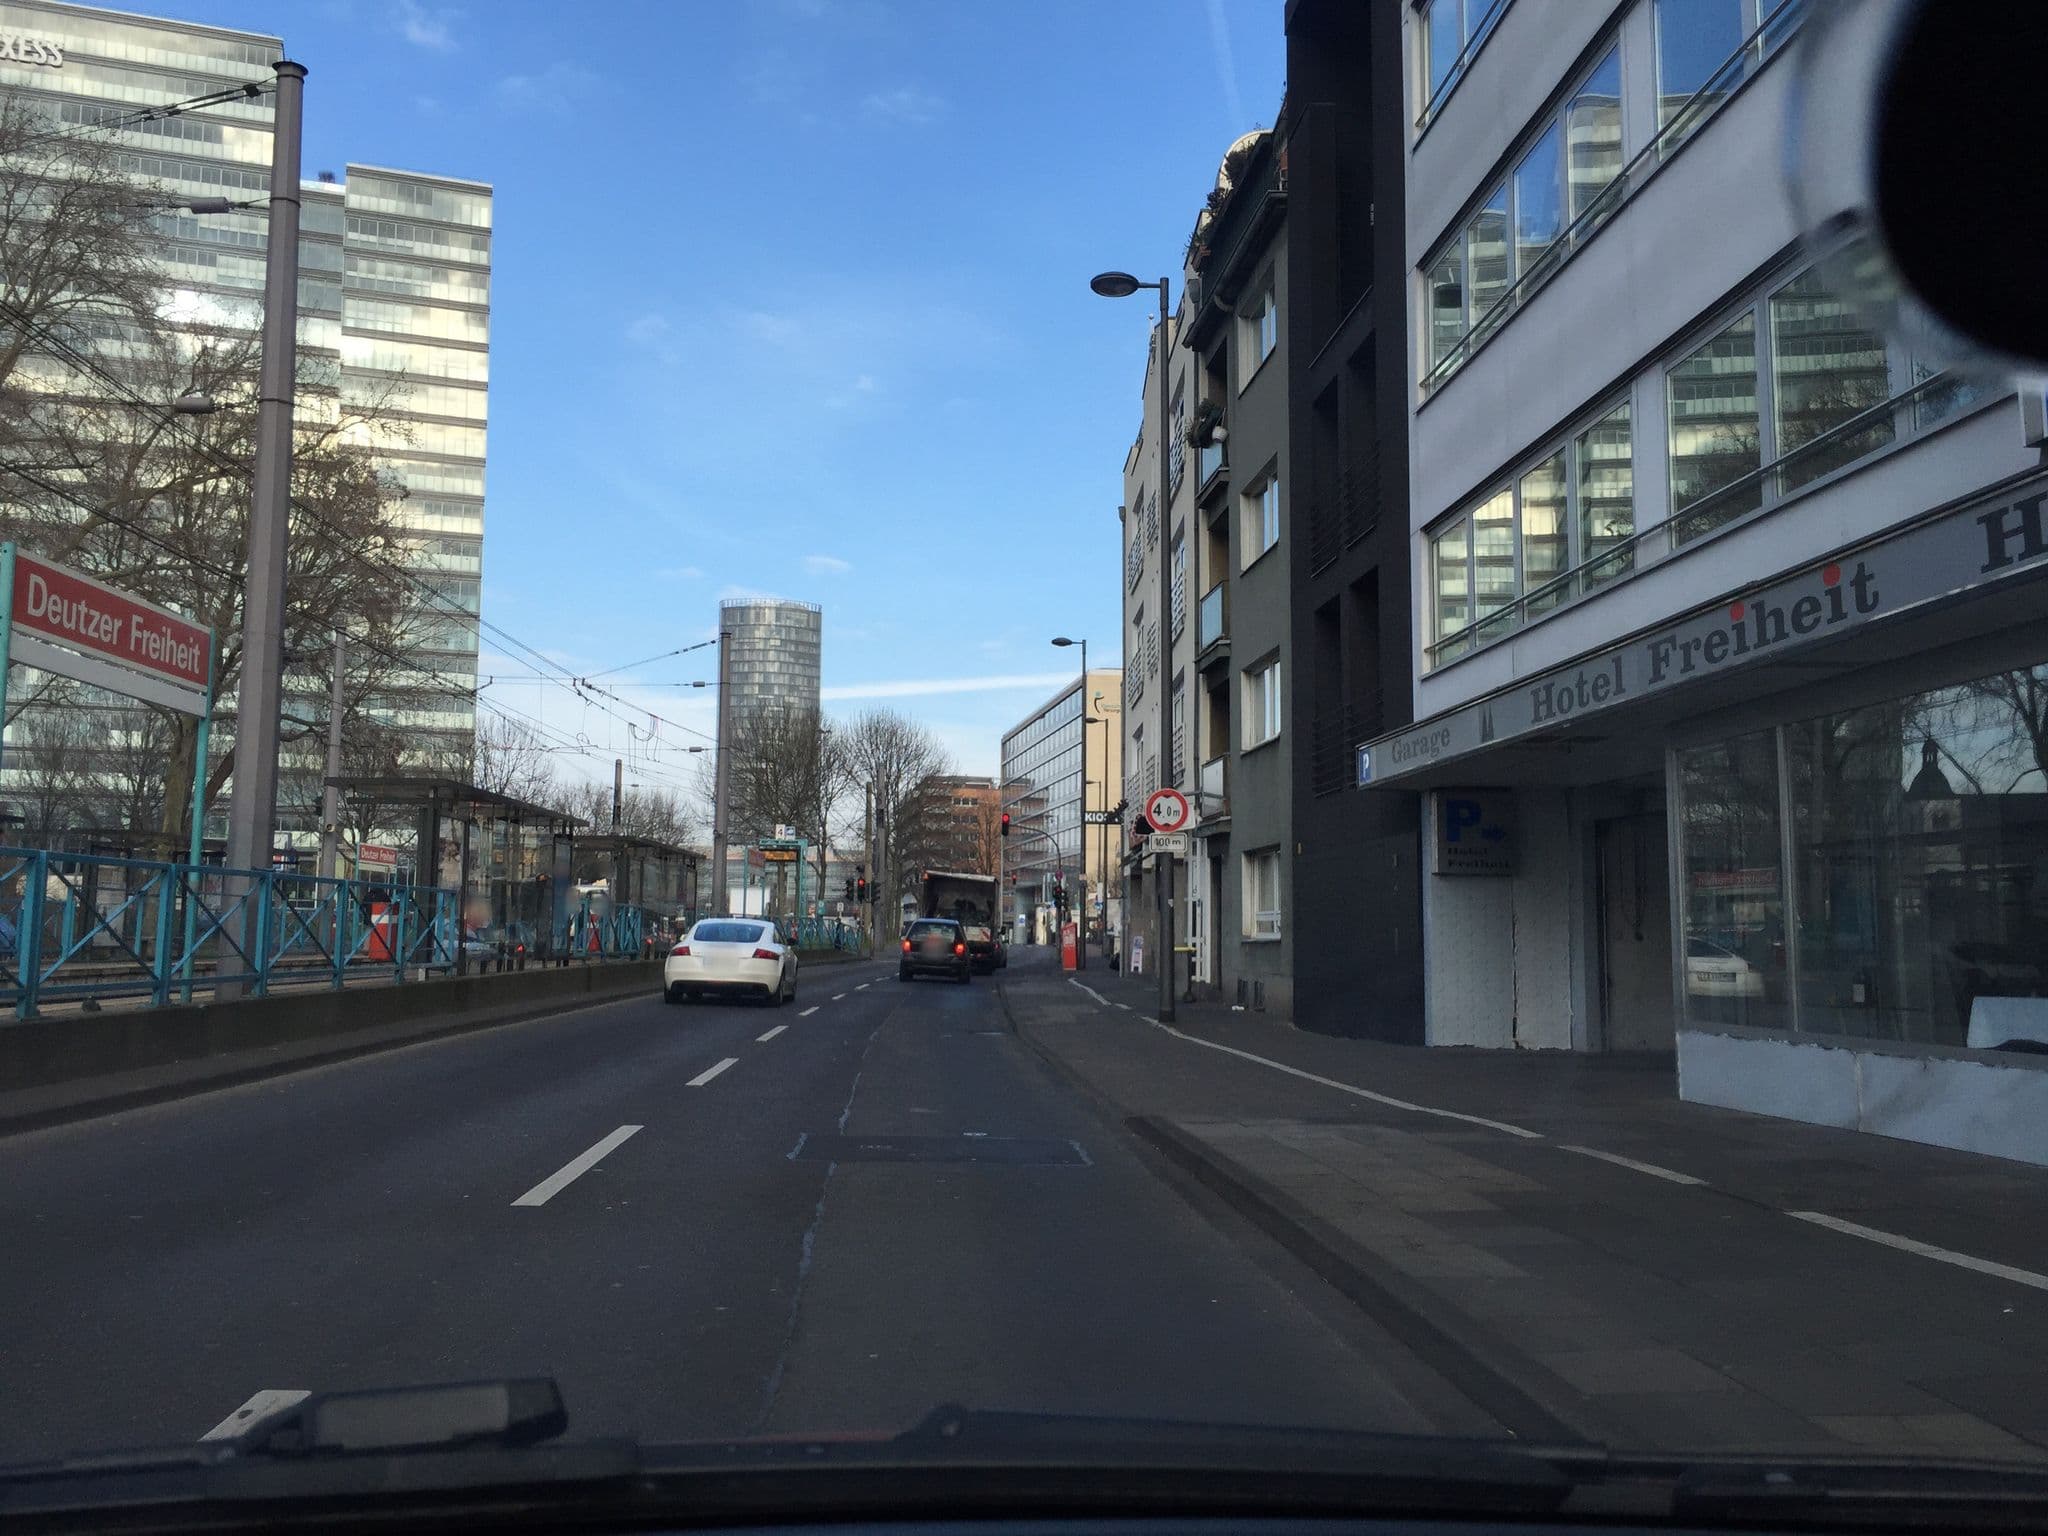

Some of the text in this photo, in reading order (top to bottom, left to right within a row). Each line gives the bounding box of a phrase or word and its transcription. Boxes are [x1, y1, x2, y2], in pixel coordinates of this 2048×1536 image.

[27, 573, 200, 674] Deutzer Freiheit
[1530, 562, 1880, 724] Hotel Freiheit
[1391, 727, 1451, 763] Garage
